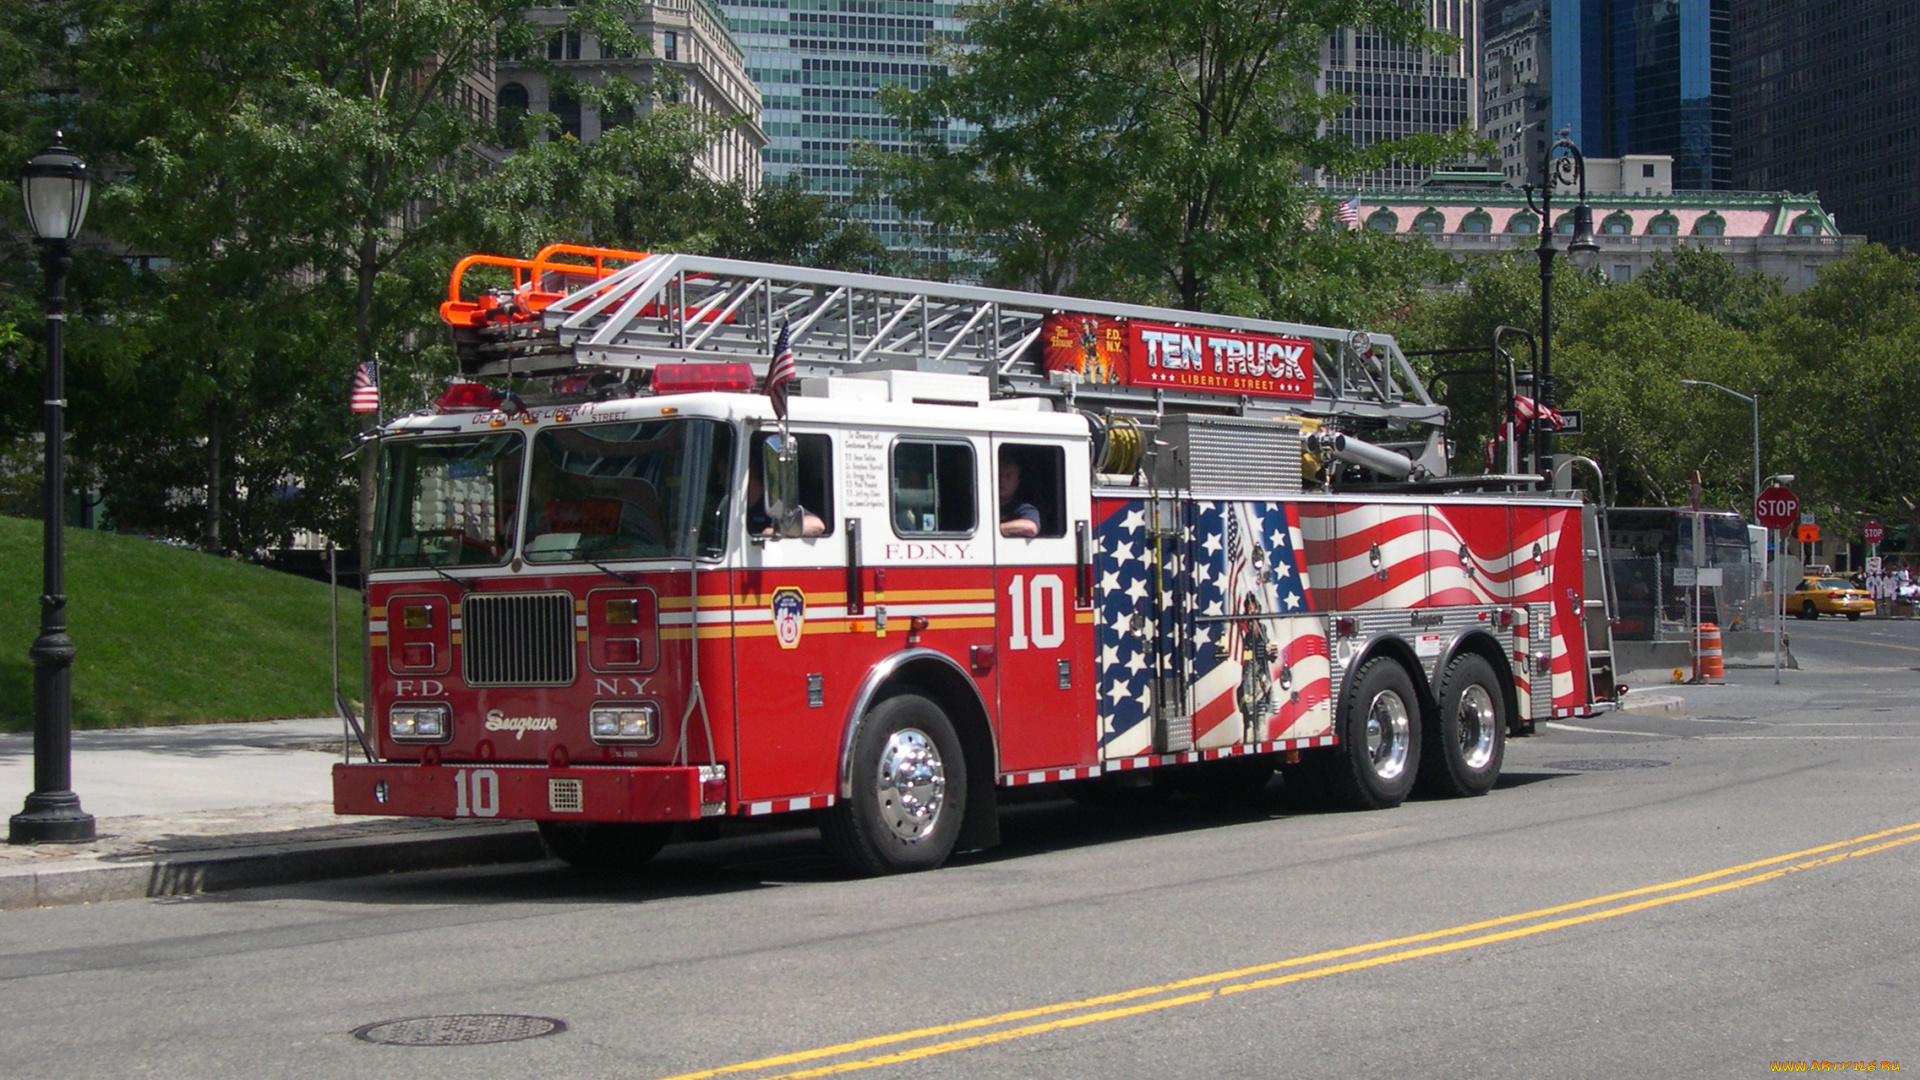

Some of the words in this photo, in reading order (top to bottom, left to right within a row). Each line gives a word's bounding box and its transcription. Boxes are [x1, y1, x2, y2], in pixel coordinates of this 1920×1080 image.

[1054, 325, 1069, 338] Ten
[1050, 336, 1074, 349] House
[1141, 330, 1204, 372] TEN
[1208, 336, 1305, 381] TRUCK
[1180, 374, 1229, 387] LIBERTY
[1233, 378, 1275, 391] STREET
[544, 405, 597, 420] LIBERTY
[591, 411, 627, 423] STREET
[1758, 500, 1797, 517] STOP
[1864, 528, 1883, 538] STOP
[885, 543, 975, 560] F.D.N.Y.
[1008, 574, 1065, 650] 10
[395, 680, 449, 697] F.D.
[594, 678, 658, 696] N.Y.
[485, 708, 558, 741] Seagrave
[454, 769, 499, 818] 10
